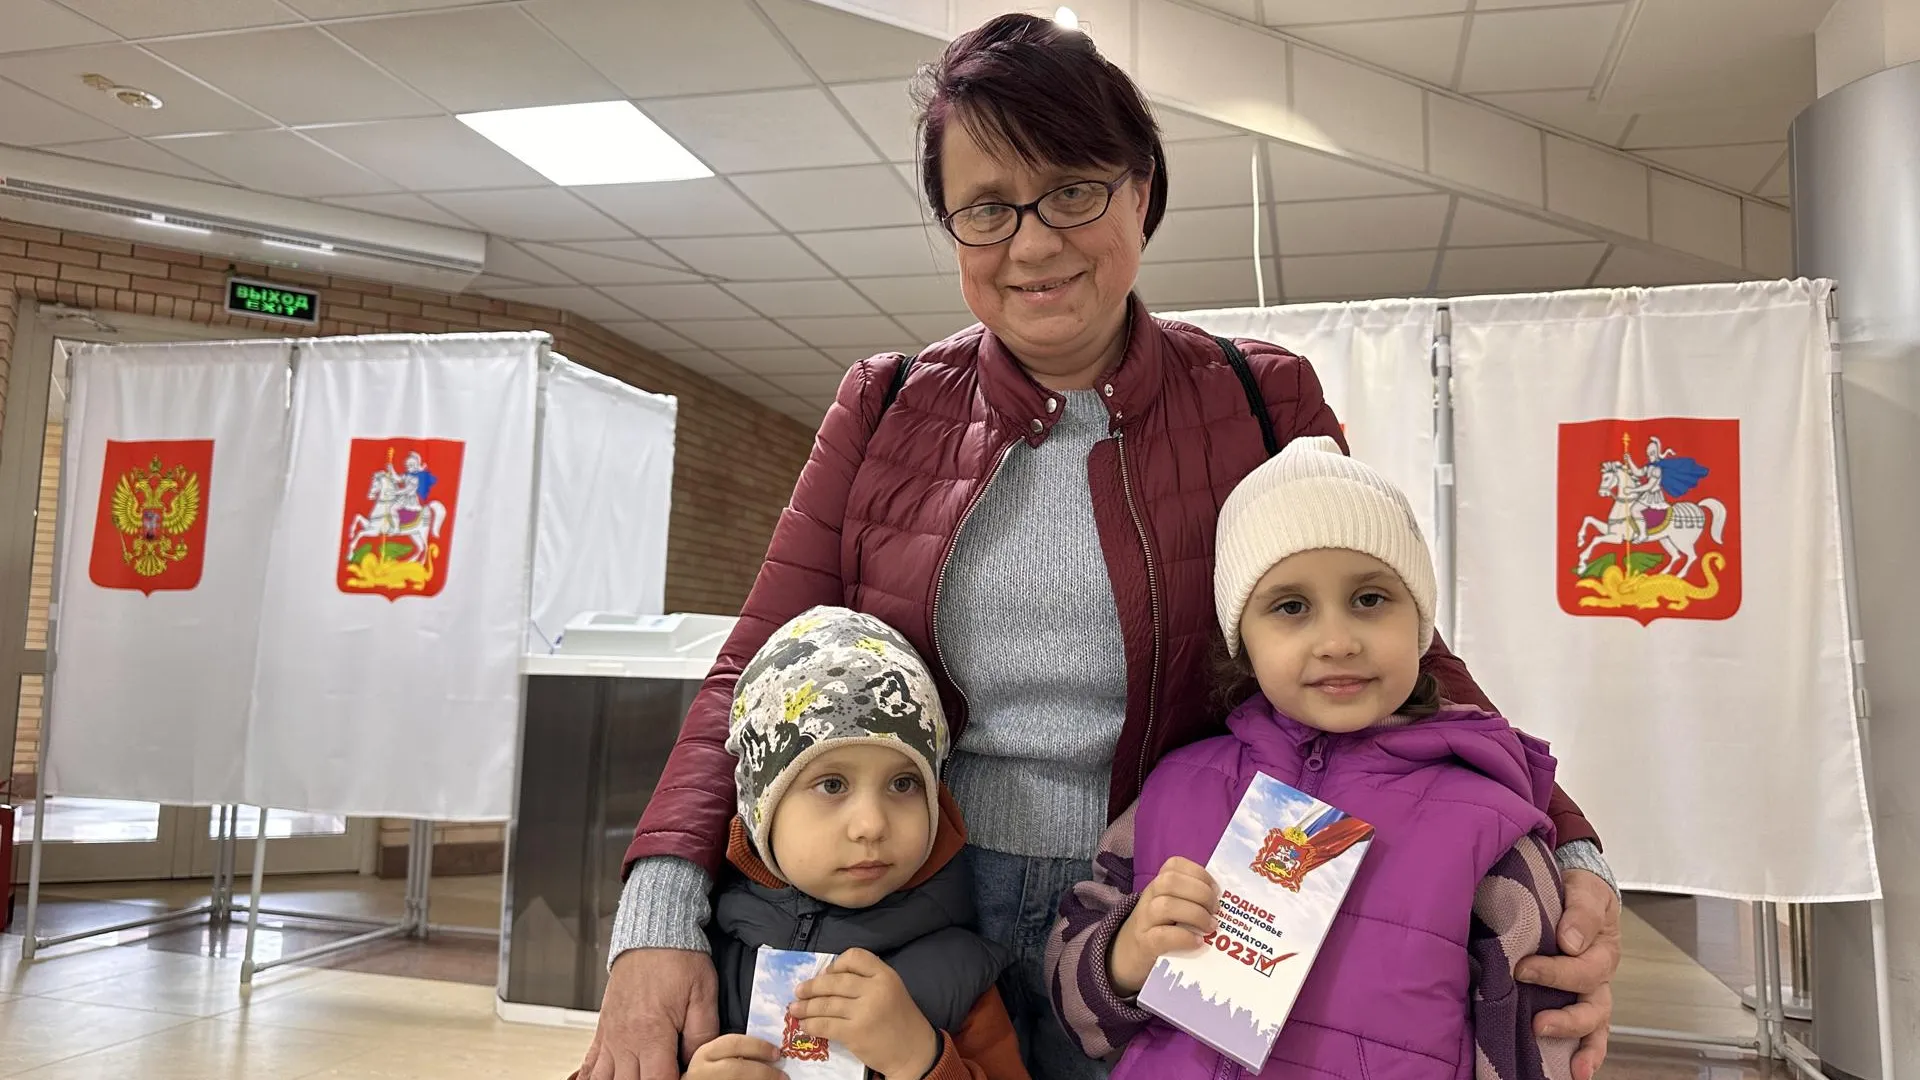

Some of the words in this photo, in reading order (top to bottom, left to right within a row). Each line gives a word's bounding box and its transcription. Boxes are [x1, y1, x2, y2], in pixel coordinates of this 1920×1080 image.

[236, 285, 309, 311] ВЫХОД
[246, 299, 297, 316] EXIT
[1219, 900, 1283, 938] ПОДМОСКОВЬЕ
[1222, 890, 1276, 924] РОДНОЕ
[1203, 931, 1258, 966] 2023
[1215, 918, 1274, 955] БЕРНАТОРА
